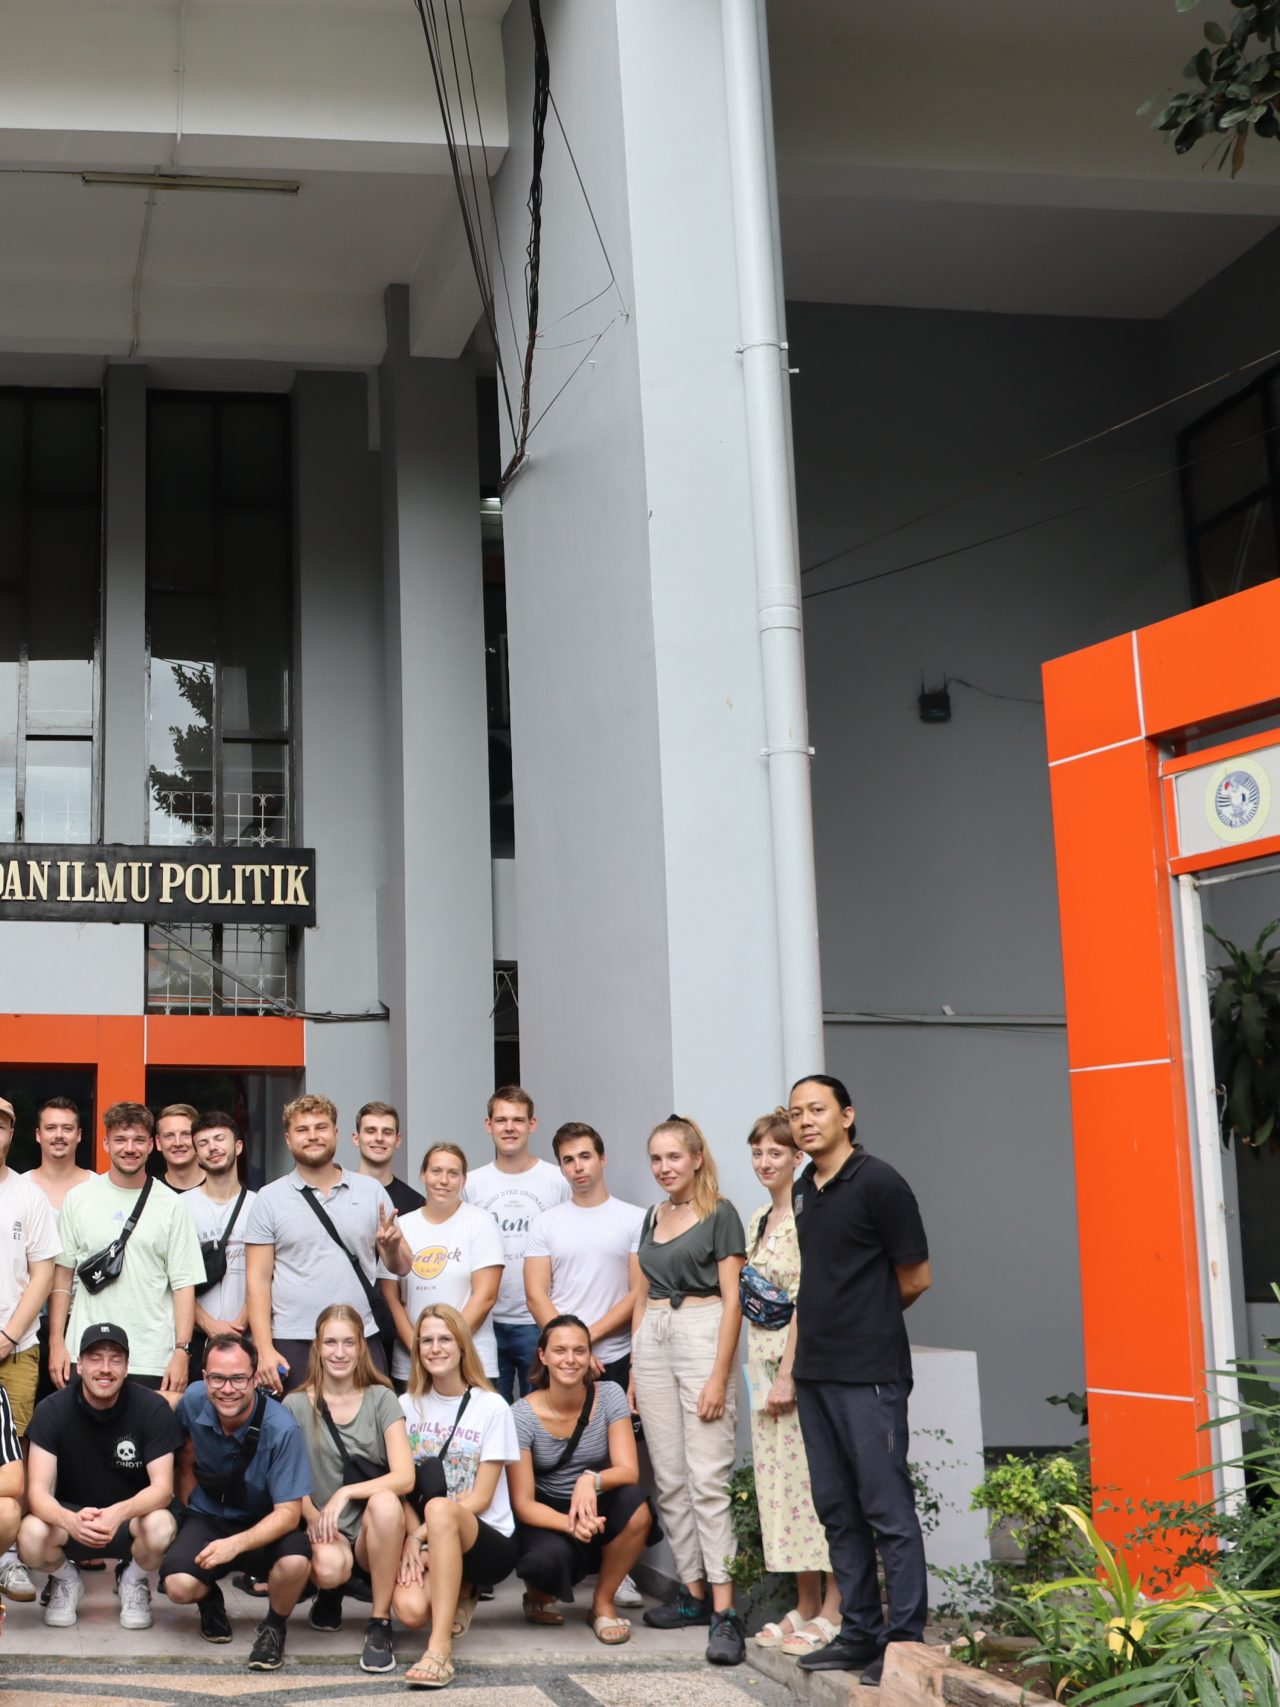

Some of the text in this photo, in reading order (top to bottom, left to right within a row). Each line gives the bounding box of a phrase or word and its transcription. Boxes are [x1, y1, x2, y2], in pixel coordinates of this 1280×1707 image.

[57, 861, 152, 903] ILMU
[159, 863, 310, 906] POLITIK
[447, 1425, 481, 1443] SNCE
